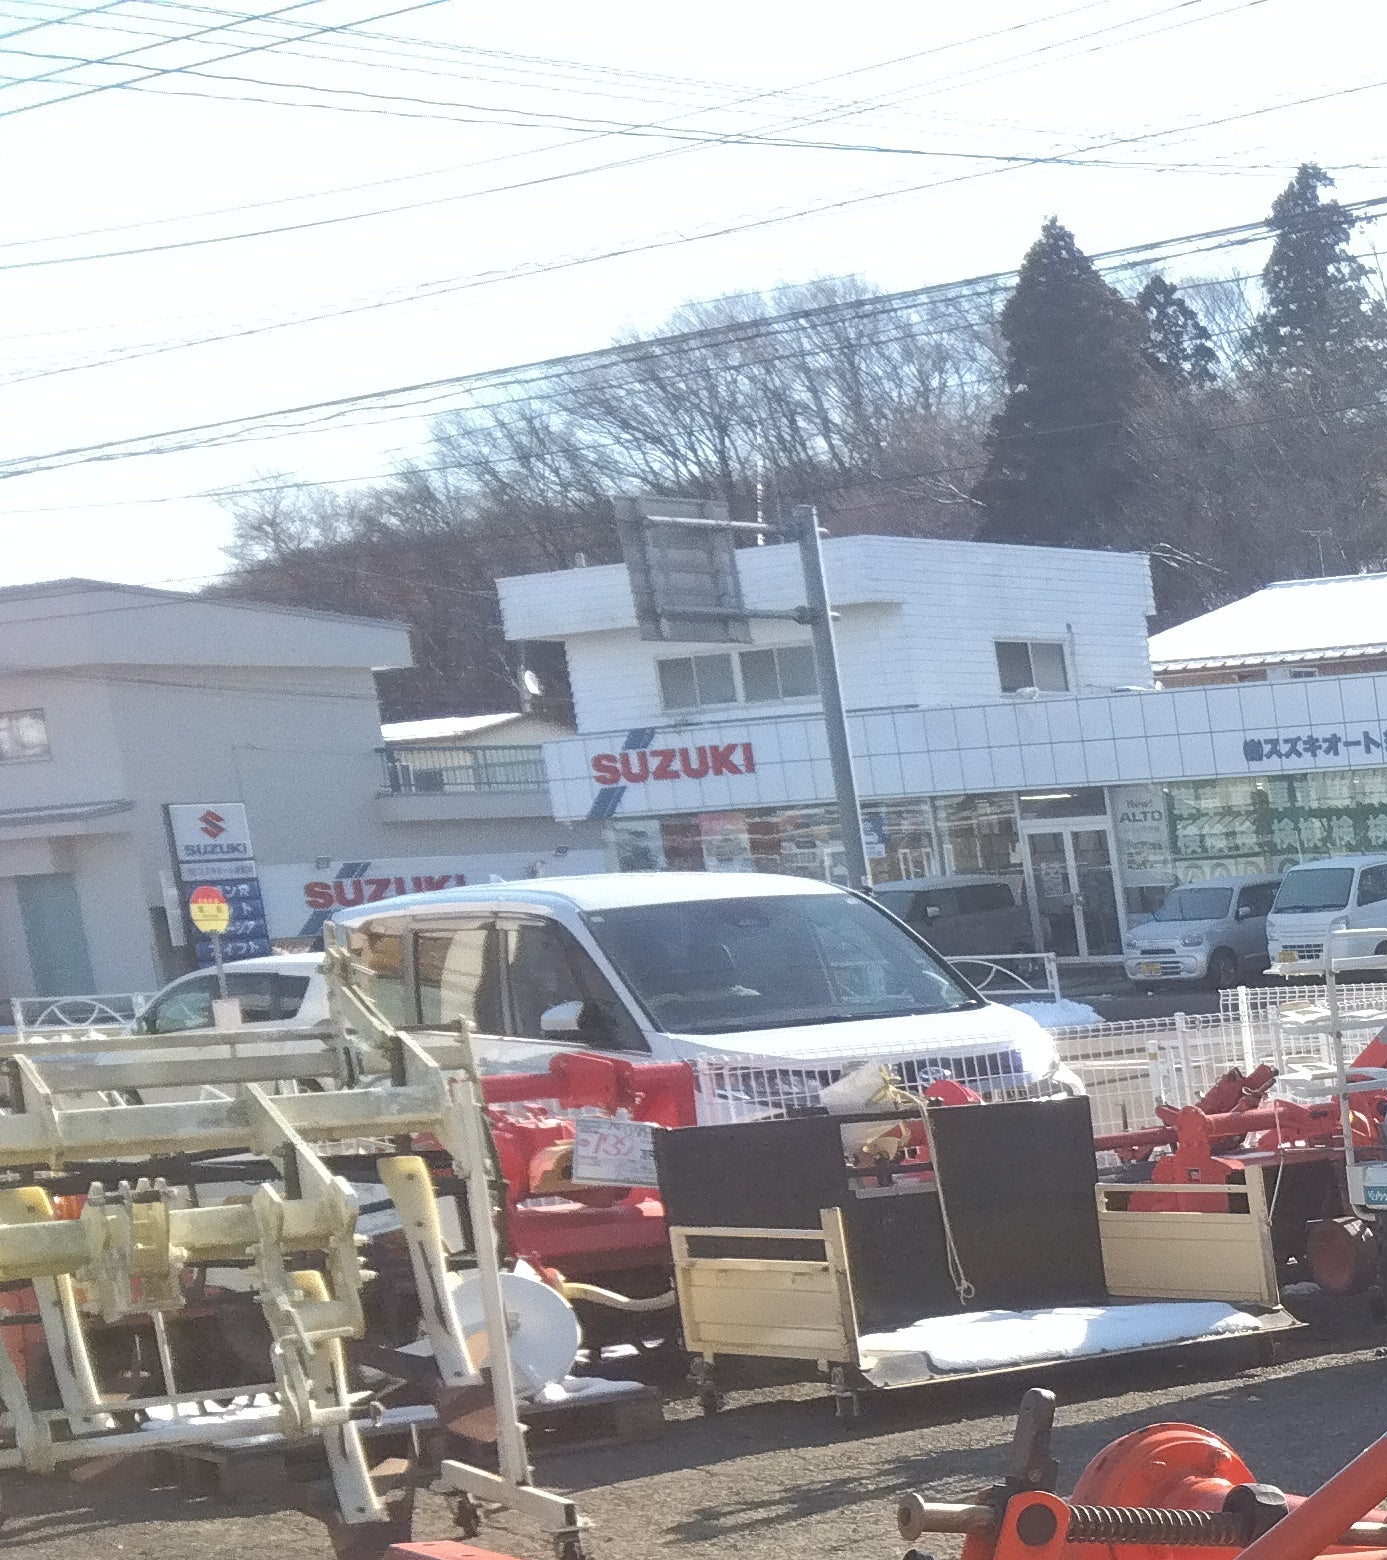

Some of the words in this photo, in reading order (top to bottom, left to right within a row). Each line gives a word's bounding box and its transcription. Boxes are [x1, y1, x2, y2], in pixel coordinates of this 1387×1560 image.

[592, 742, 756, 785] SUZUKI
[1120, 810, 1163, 823] ALTO
[184, 842, 247, 857] SUZUKI
